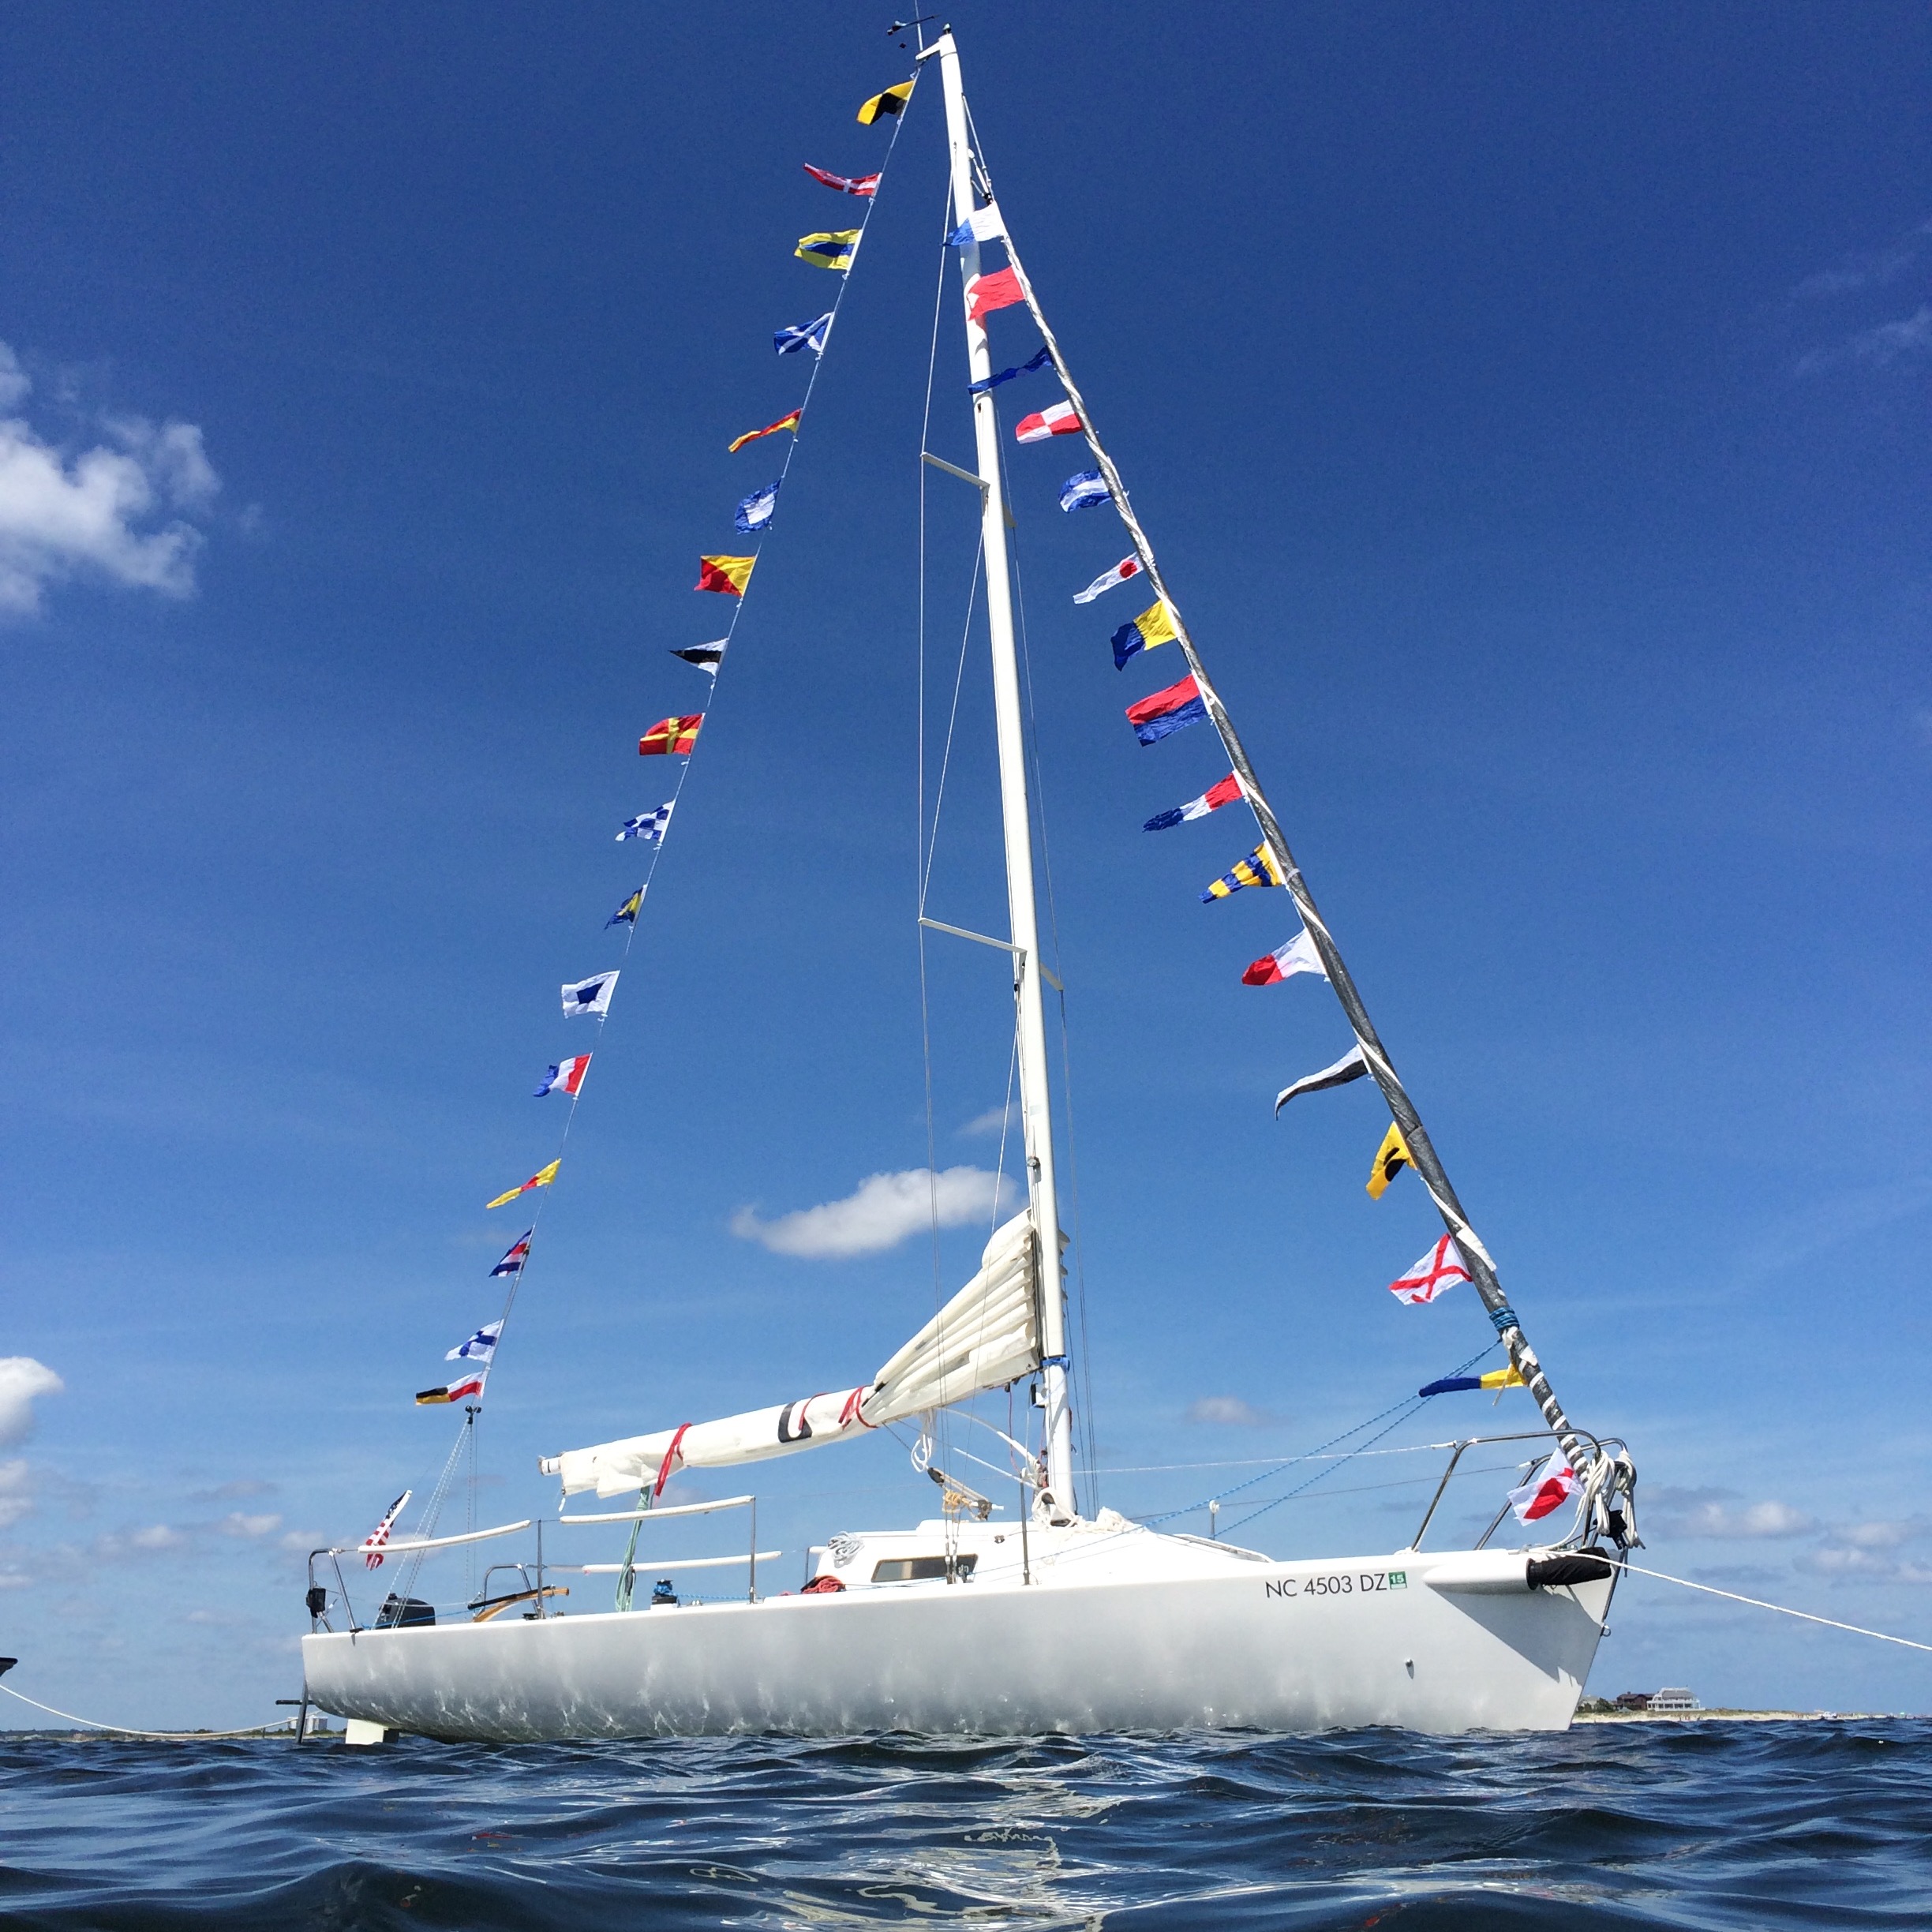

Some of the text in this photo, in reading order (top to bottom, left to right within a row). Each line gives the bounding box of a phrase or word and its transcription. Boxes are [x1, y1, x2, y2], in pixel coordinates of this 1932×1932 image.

[1265, 1574, 1387, 1597] NC 4503 DZ
[1390, 1574, 1404, 1584] 15
